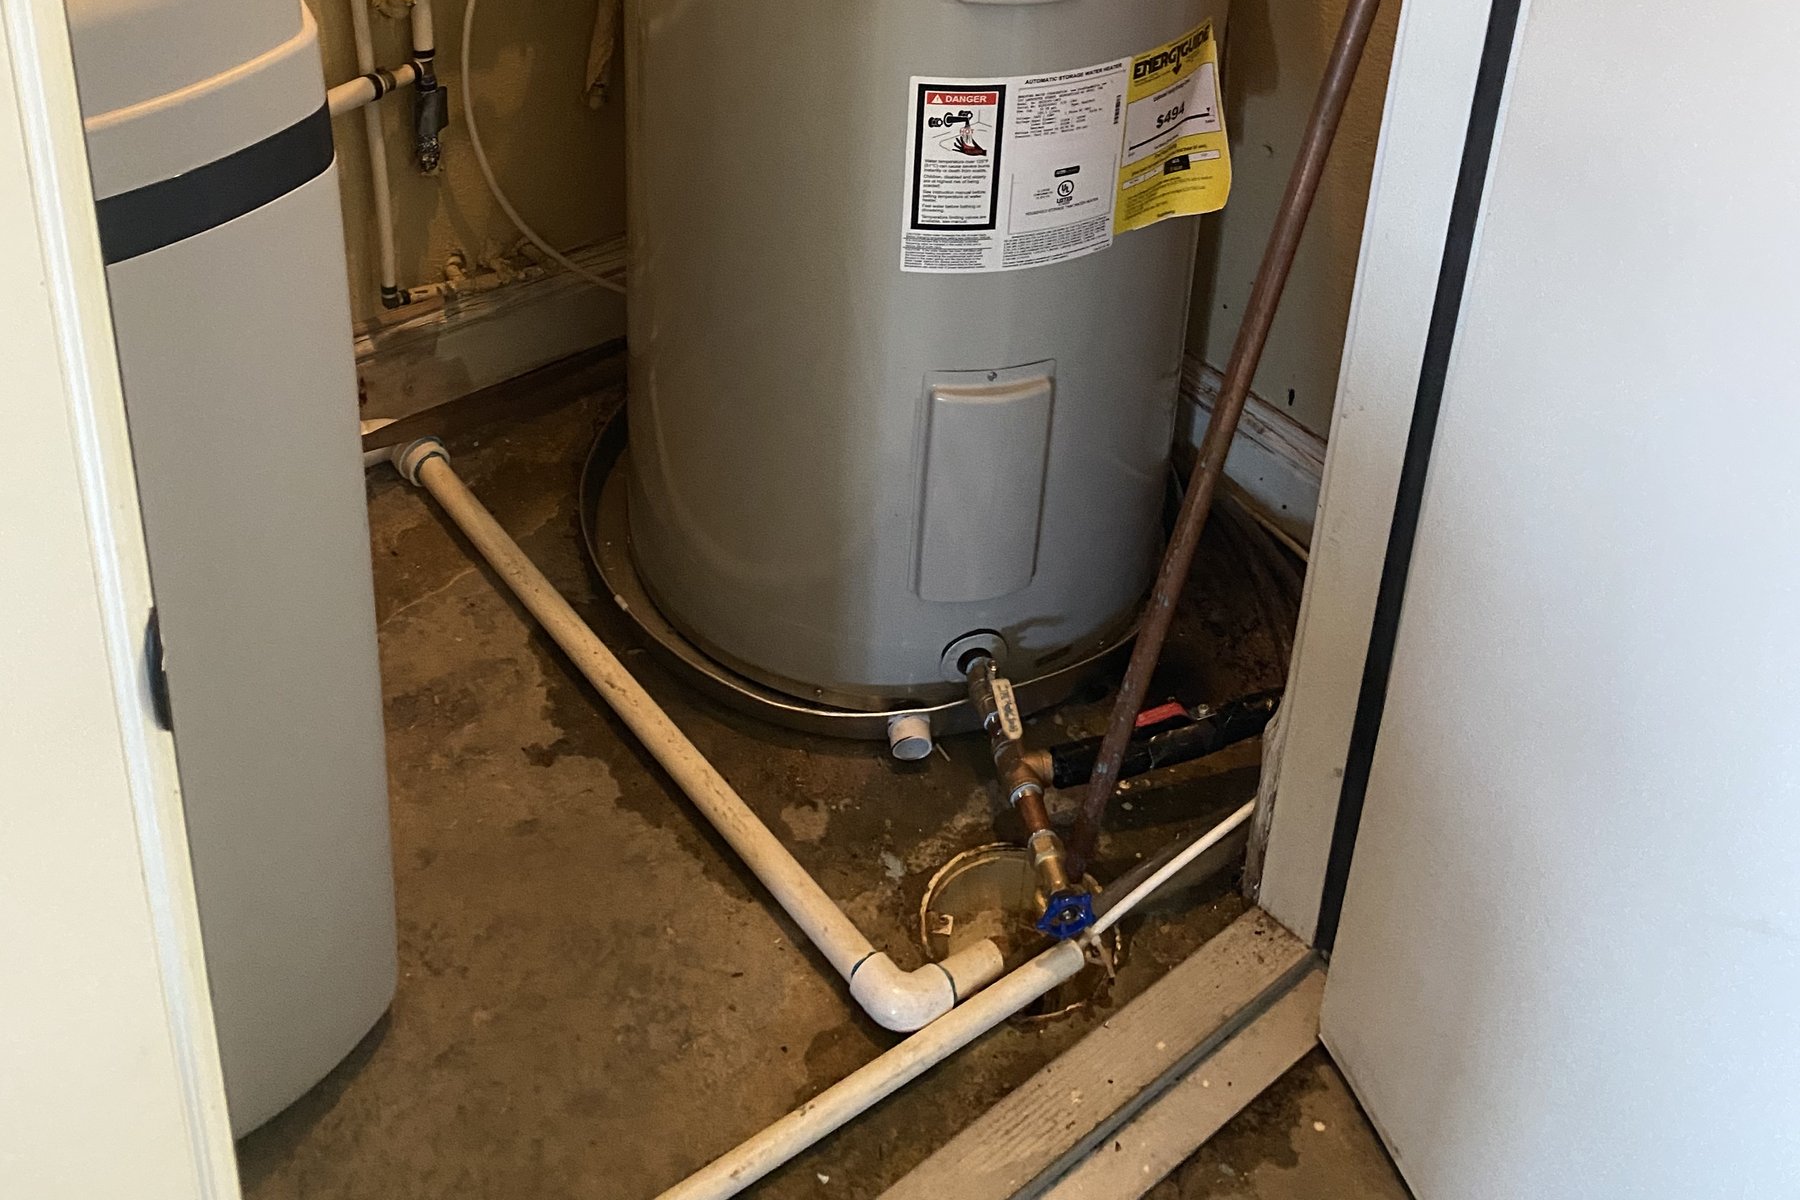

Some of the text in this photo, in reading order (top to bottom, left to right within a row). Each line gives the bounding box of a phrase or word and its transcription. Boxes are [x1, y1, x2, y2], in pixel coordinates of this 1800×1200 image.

[1025, 76, 1058, 85] AUTOMATIC
[1059, 71, 1084, 81] STORAGE
[945, 95, 987, 103] DANGER
